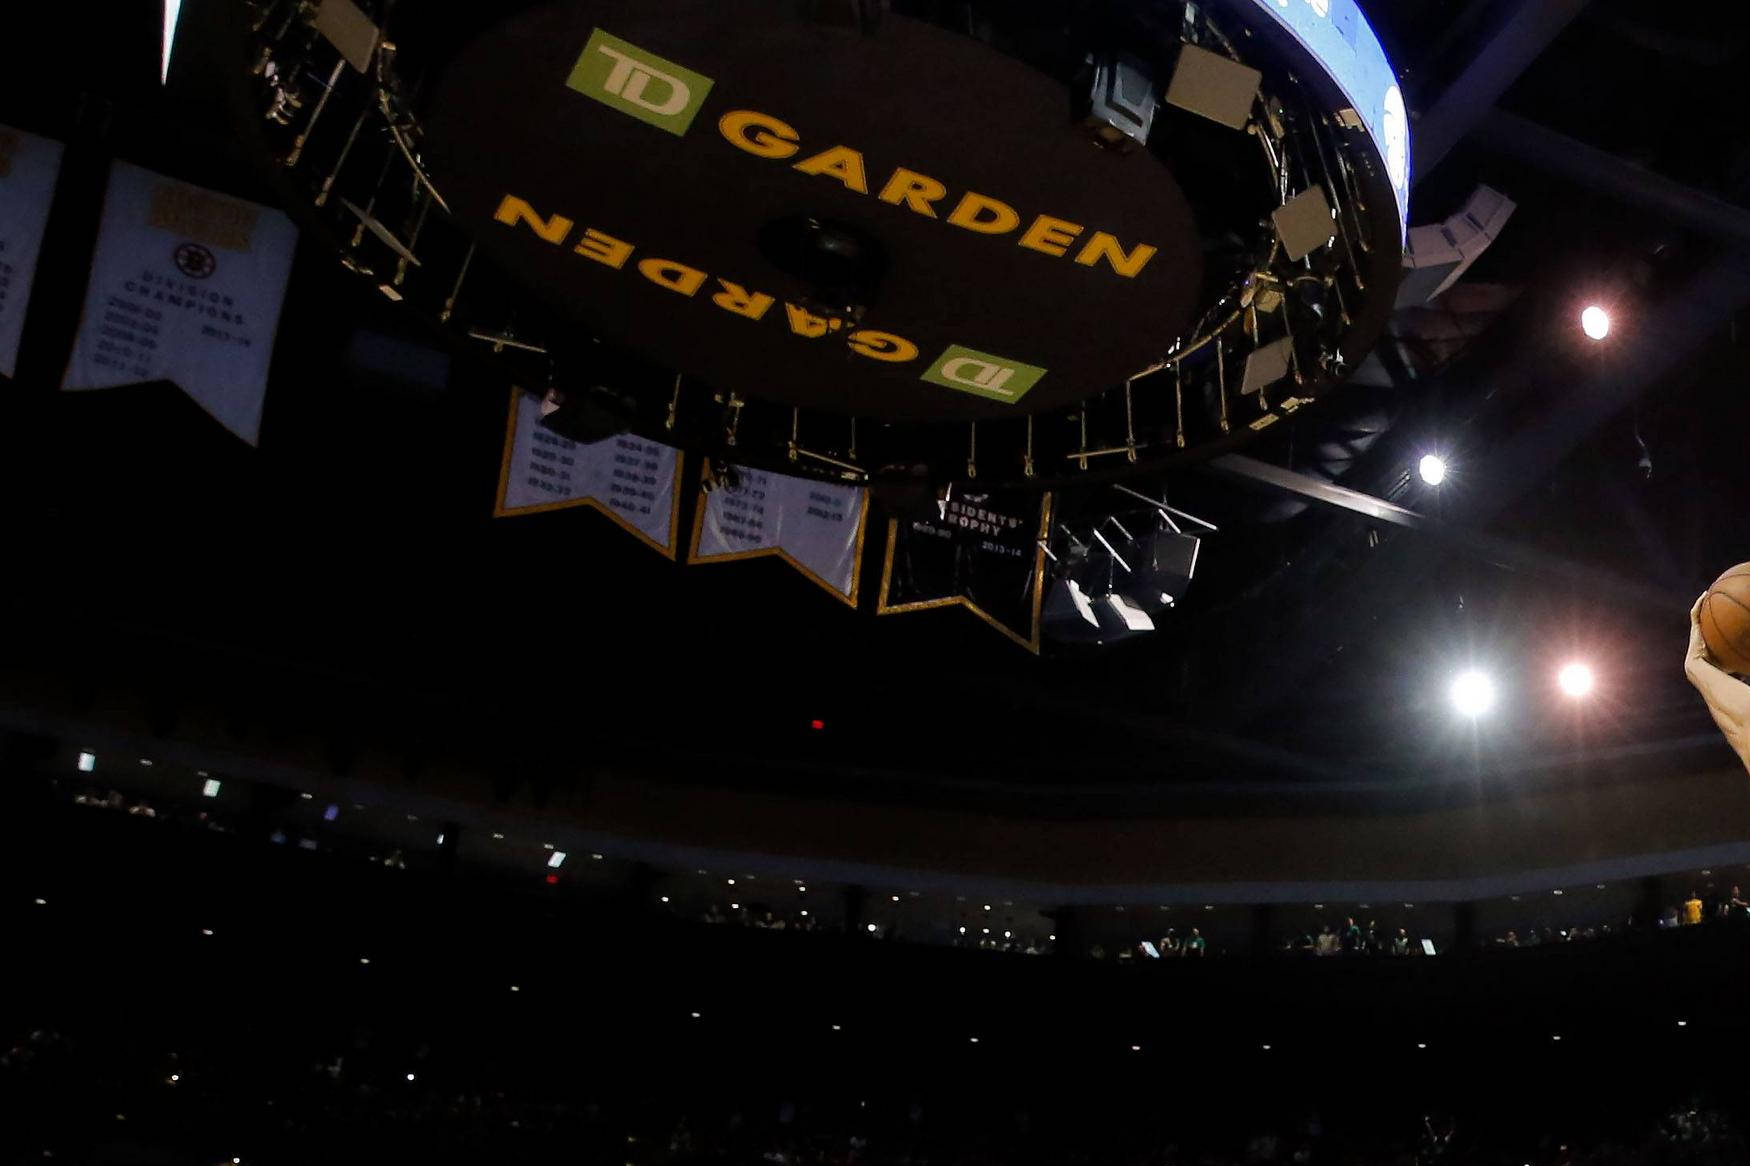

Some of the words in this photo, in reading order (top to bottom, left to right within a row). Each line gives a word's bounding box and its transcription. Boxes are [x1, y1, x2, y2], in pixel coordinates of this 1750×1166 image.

[599, 44, 691, 117] TD
[719, 109, 1157, 278] GARDEN
[125, 280, 243, 326] CHAMPIONS
[494, 195, 919, 363] GARDEN
[947, 513, 1001, 537] ROPHY
